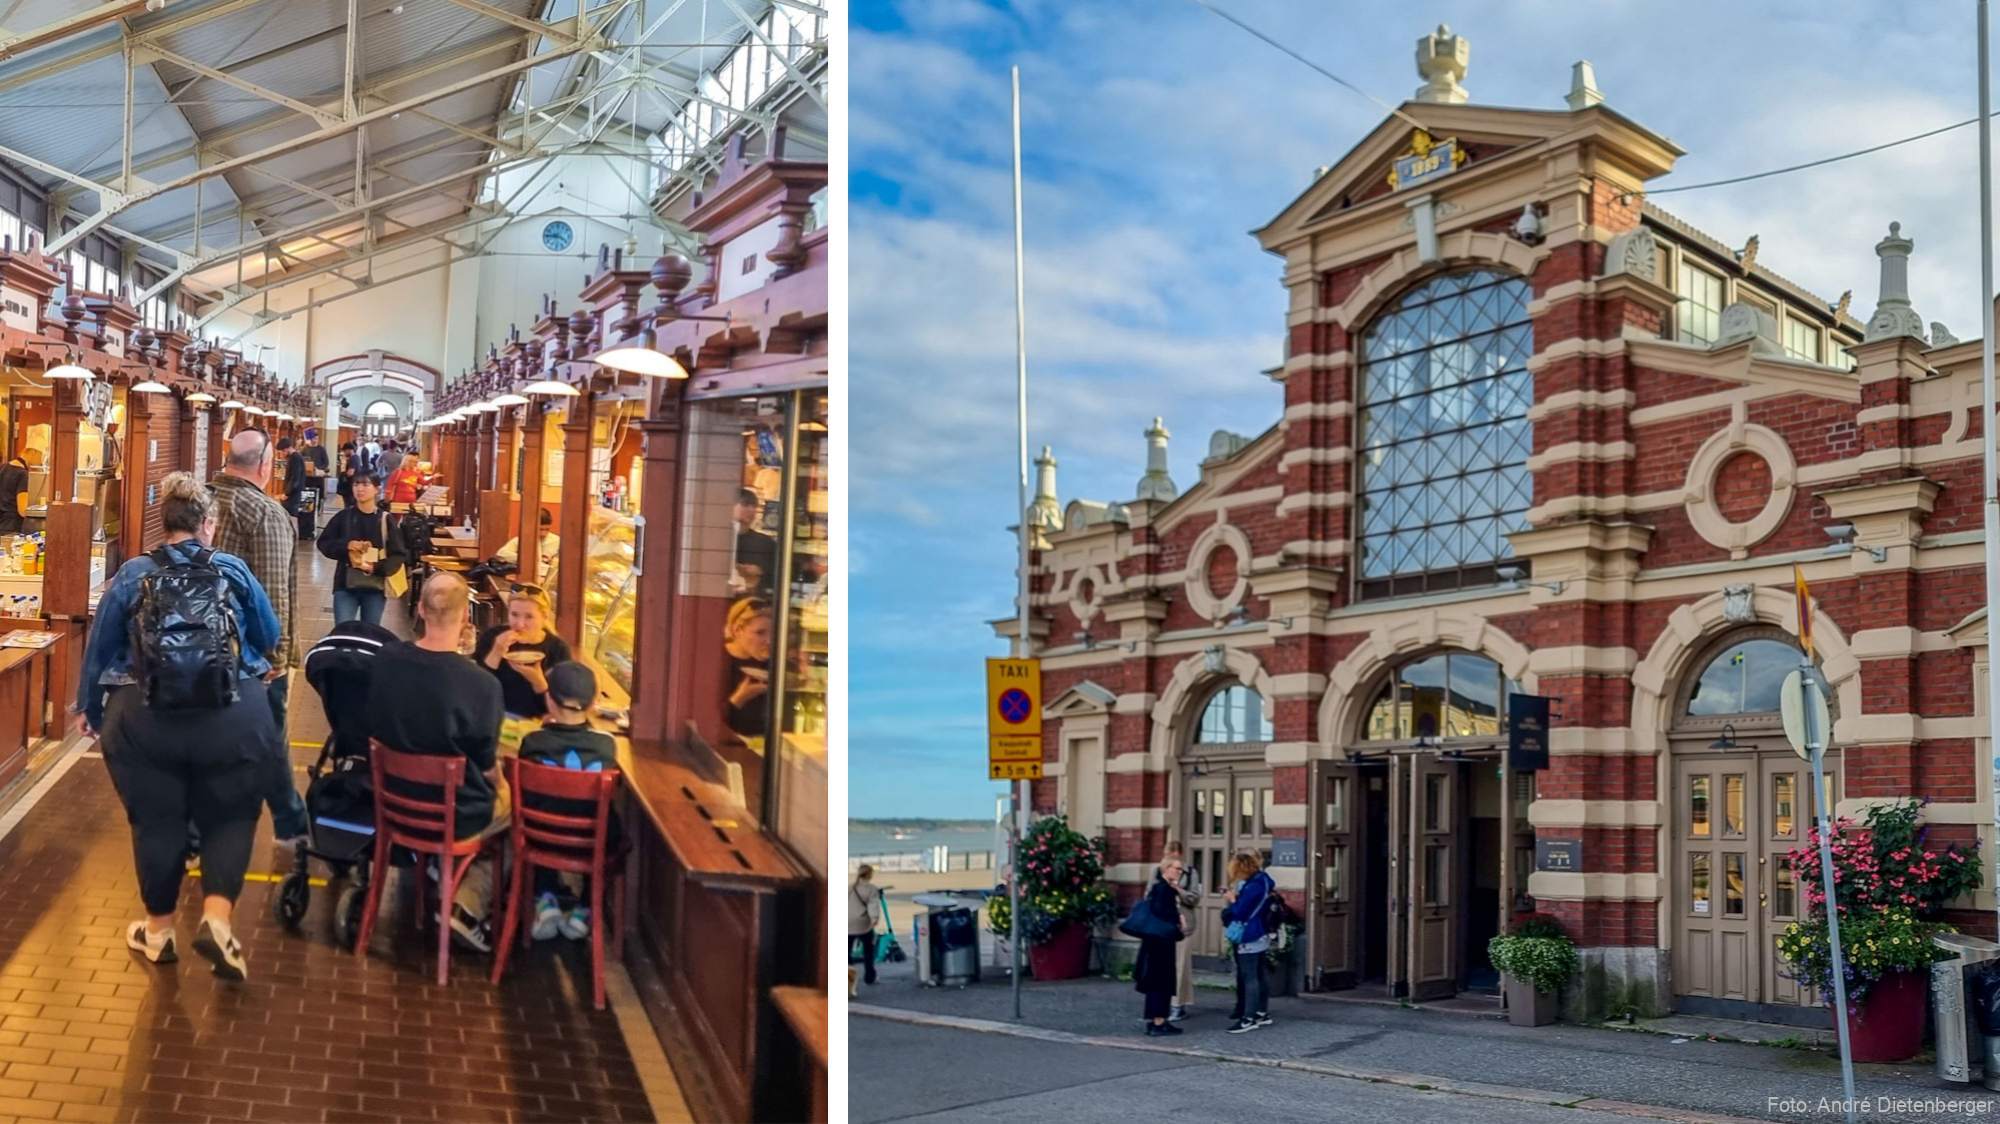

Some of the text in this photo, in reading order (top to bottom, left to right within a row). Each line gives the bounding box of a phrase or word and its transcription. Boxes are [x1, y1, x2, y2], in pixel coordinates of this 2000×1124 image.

[999, 665, 1029, 678] TAXI
[1007, 765, 1026, 775] 5 m
